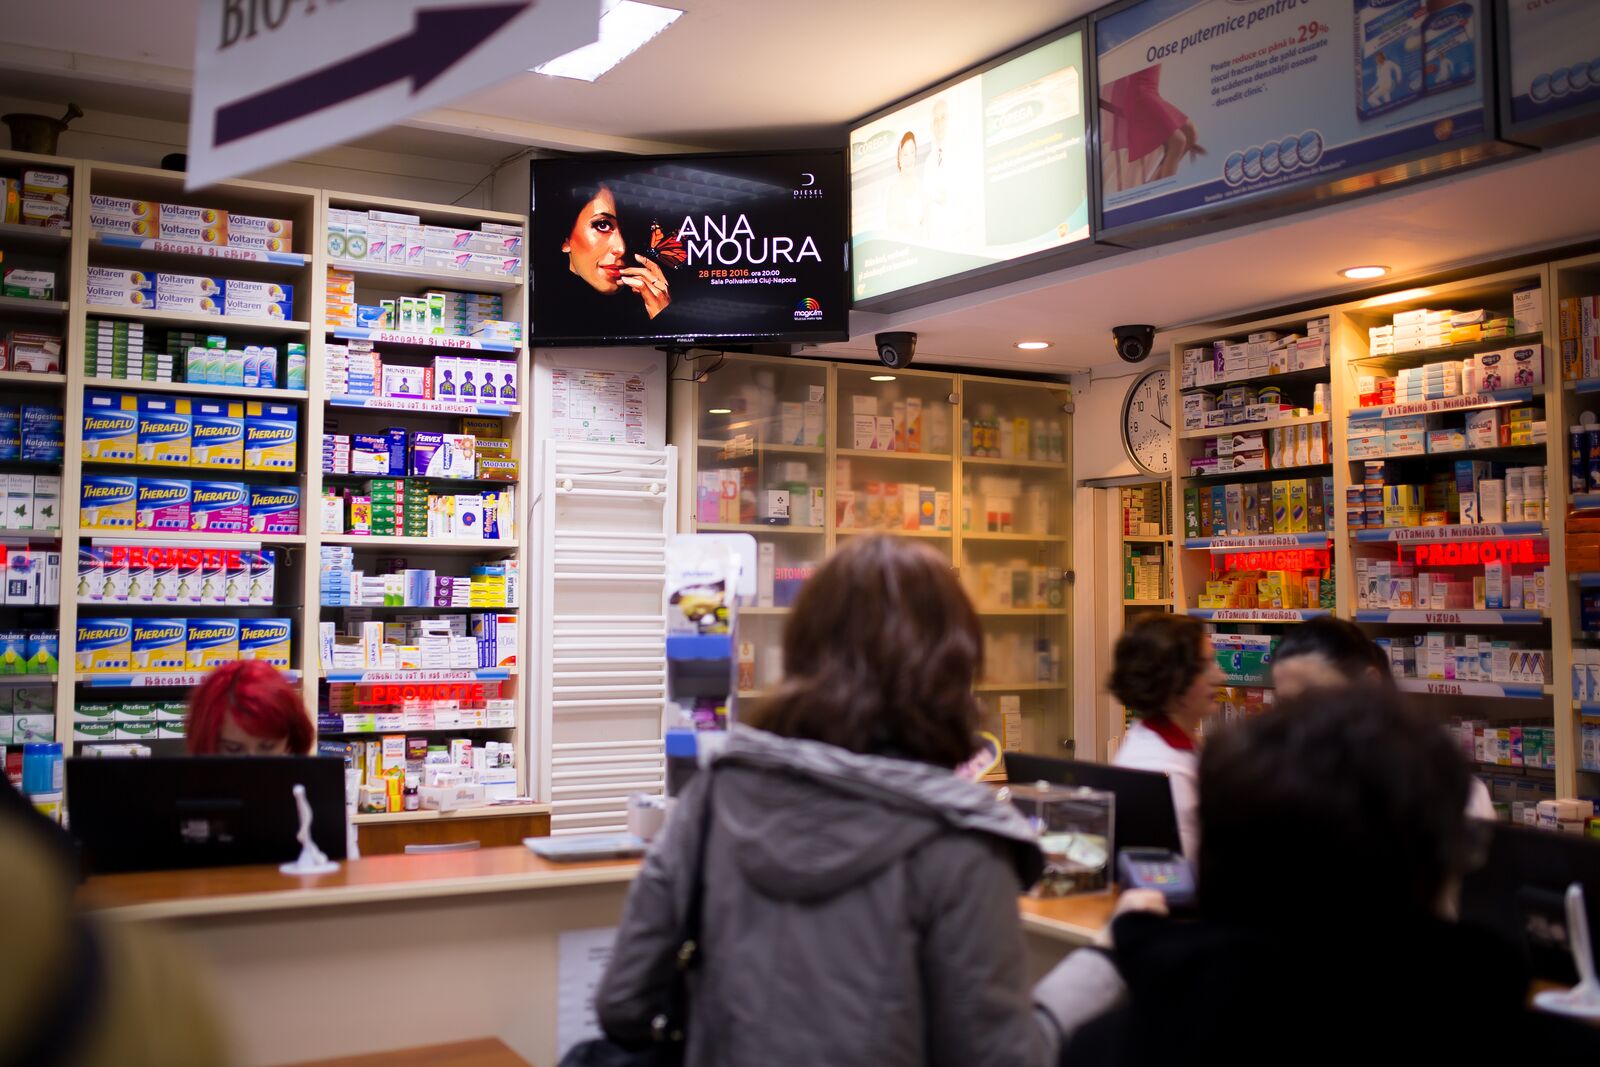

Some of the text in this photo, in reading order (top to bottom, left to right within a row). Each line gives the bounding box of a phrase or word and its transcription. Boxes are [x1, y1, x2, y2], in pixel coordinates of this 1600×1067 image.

[1146, 42, 1179, 62] Oase
[1181, 16, 1245, 53] puternice
[1211, 60, 1231, 72] Poate
[1232, 50, 1256, 64] reduce
[1257, 47, 1267, 57] cu
[1288, 36, 1296, 47] la
[1297, 21, 1329, 43] 29%
[1211, 71, 1229, 84] riscul
[1231, 59, 1267, 79] fracturilor
[1269, 53, 1279, 64] de
[1211, 84, 1220, 96] de
[90, 195, 131, 209] Voltaren
[161, 204, 200, 216] Voltaren
[90, 215, 131, 228] Voltaren
[228, 215, 266, 227] Voltaren
[161, 223, 200, 236] Voltaren
[675, 213, 756, 242] ANA
[227, 234, 265, 245] Voltaren
[687, 235, 822, 266] MOURA
[87, 267, 124, 279] Voltaren
[698, 270, 710, 278] 28
[711, 269, 728, 277] FEB
[729, 269, 749, 277] 2016
[762, 269, 780, 277] 20:00
[159, 274, 195, 285] Voltaren
[759, 277, 796, 285] Cluj-Napoca
[86, 286, 124, 298] Voltaren
[227, 281, 263, 291] Voltaren
[158, 293, 194, 304] Voltaren
[227, 300, 262, 310] Voltaren
[1159, 379, 1166, 390] 12
[1145, 387, 1152, 398] 11
[1137, 401, 1144, 411] 10
[84, 417, 134, 430] THERAFLU
[140, 421, 189, 433] THERAFLU
[194, 425, 241, 437] THERAFLU
[247, 427, 293, 439] THERAFLU
[416, 434, 442, 443] FERVEX
[1162, 453, 1168, 463] 6
[483, 461, 515, 469] MODAFEN
[83, 485, 133, 498] THERAFLU
[139, 487, 188, 500] THERAFLU
[193, 490, 240, 502] THERAFLU
[252, 494, 297, 505] THERAFLU
[112, 545, 241, 569] PROMOTIE
[1415, 539, 1534, 565] PROMOTIE
[1225, 549, 1315, 571] PROMOTIE
[78, 627, 129, 641] THERAFLU
[134, 627, 183, 641] THERAFLU
[188, 628, 237, 641] THERAFLU
[241, 627, 287, 640] THERAFLU
[371, 683, 485, 704] PROMOTIE
